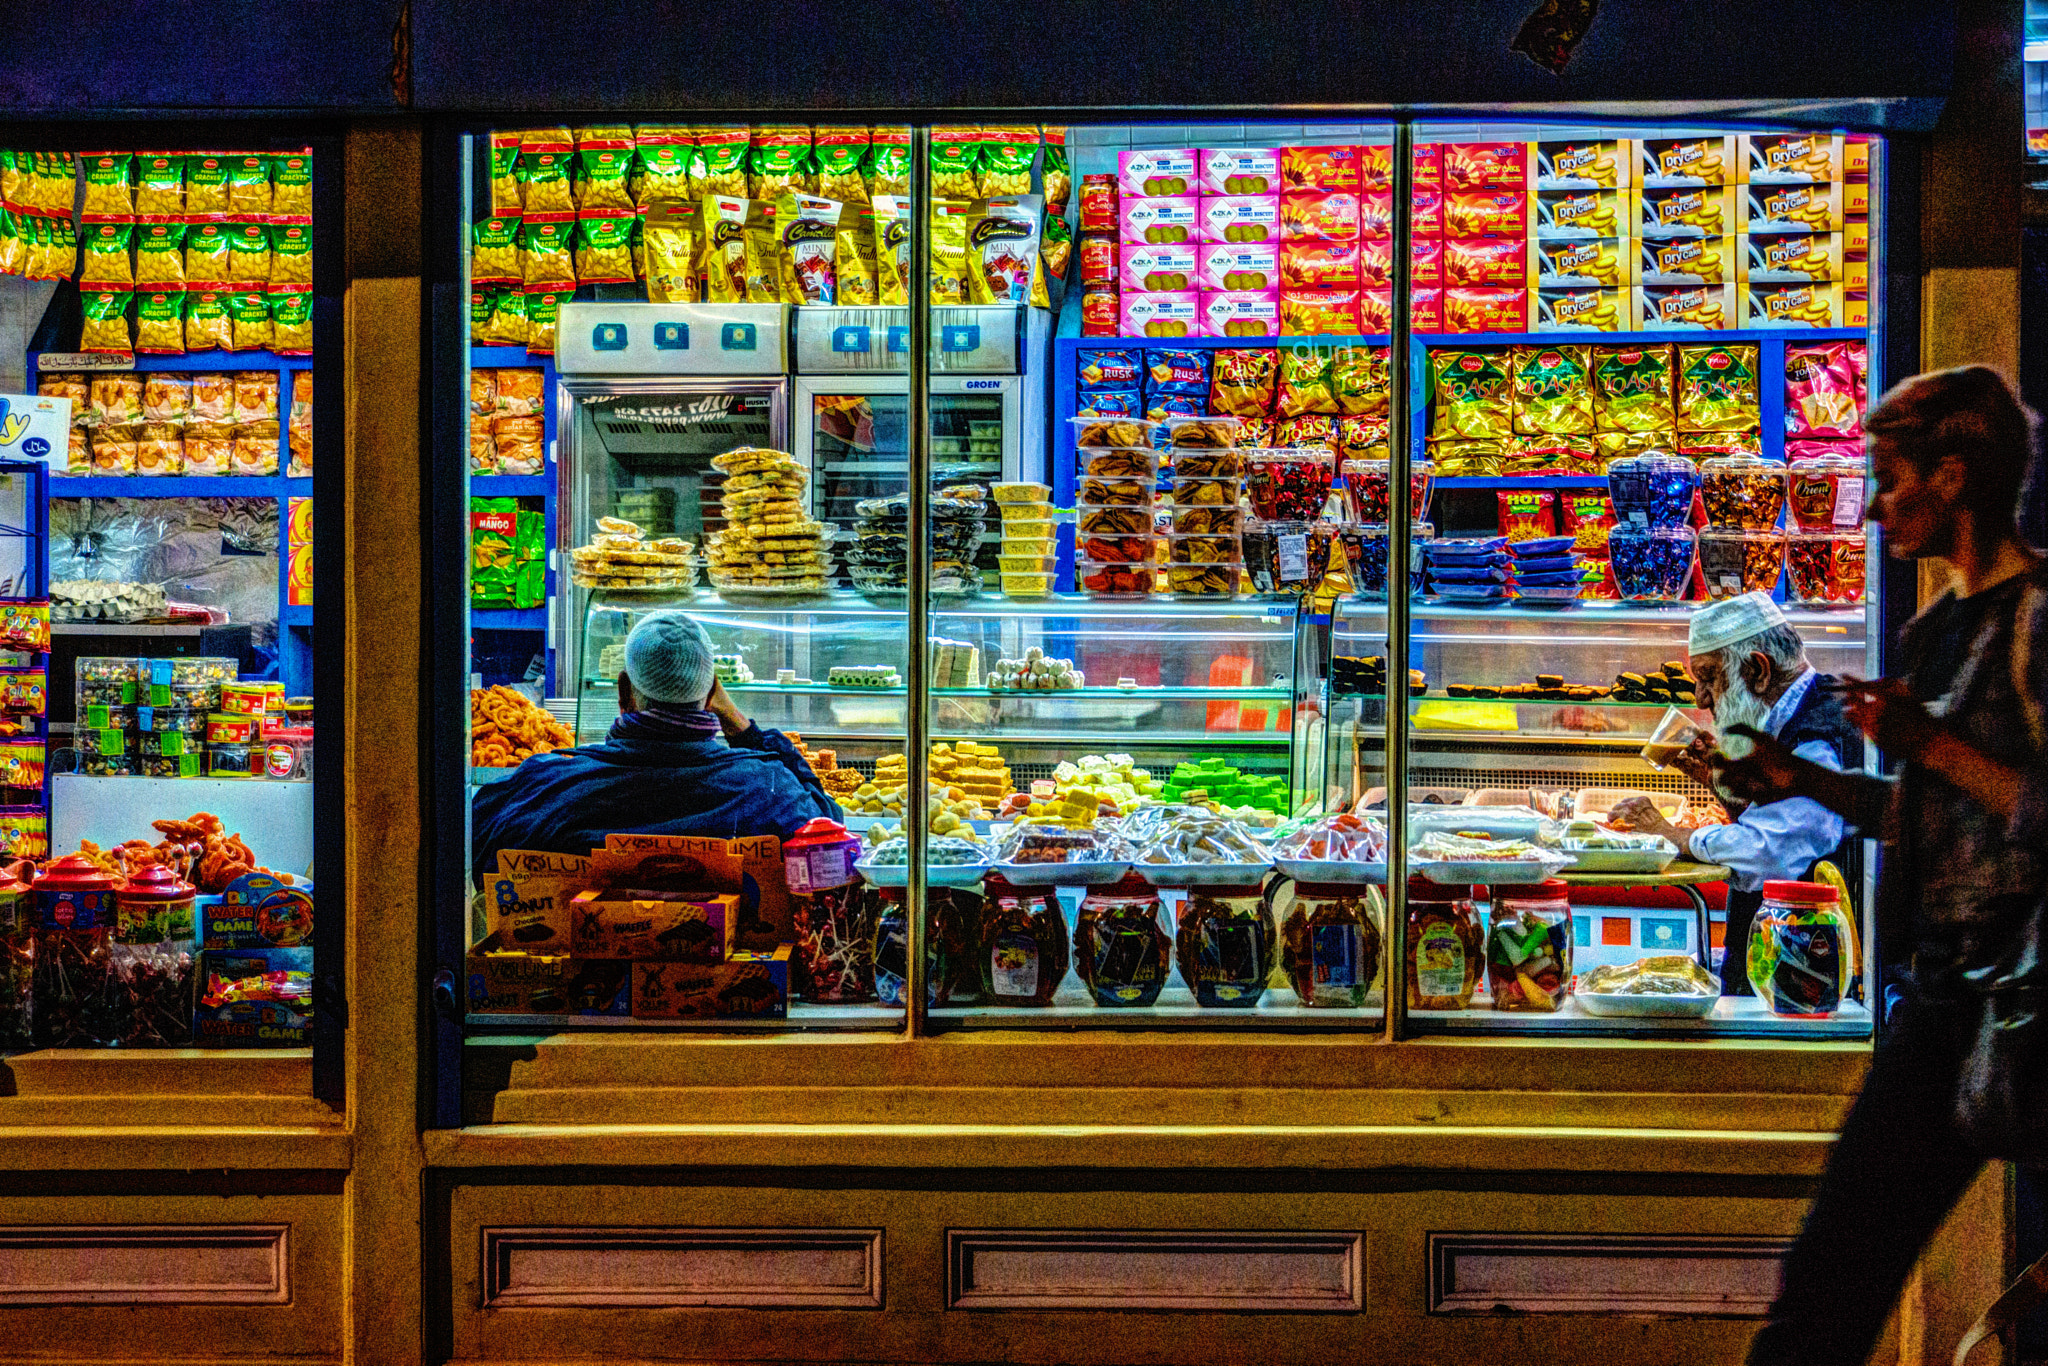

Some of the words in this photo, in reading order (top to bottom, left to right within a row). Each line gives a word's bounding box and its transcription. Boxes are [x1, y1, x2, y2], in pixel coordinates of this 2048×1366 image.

[1492, 148, 1519, 156] AZKA
[1666, 154, 1684, 167] Dry
[1684, 151, 1703, 162] Cake
[1772, 150, 1791, 163] Dry
[1791, 146, 1810, 158] Cake
[1560, 156, 1578, 169] Dry
[1578, 154, 1596, 165] Cake
[590, 168, 620, 176] CRACKER
[1559, 205, 1578, 218] Dry
[1578, 202, 1596, 214] Cake
[1665, 203, 1683, 216] Dry
[1683, 200, 1702, 211] Cake
[1771, 200, 1789, 212] Dry
[1789, 196, 1809, 208] Cake
[803, 244, 827, 252] MINI
[1664, 251, 1683, 264] Dry
[1682, 248, 1702, 260] Cake
[1771, 250, 1789, 262] Dry
[1790, 245, 1809, 257] Cake
[1561, 253, 1579, 266] Dry
[1579, 250, 1598, 262] Cake
[1560, 302, 1578, 315] Dry
[1578, 298, 1597, 310] Cake
[1666, 300, 1683, 313] Dry
[1683, 296, 1702, 308] Cake
[1772, 299, 1790, 311] Dry
[1790, 294, 1810, 306] Cake
[1217, 355, 1268, 380] Toast
[1786, 355, 1824, 372] SWEET
[1104, 369, 1132, 378] RUSK
[1174, 369, 1201, 380] RUSK
[1795, 367, 1817, 377] TOAS
[966, 381, 1000, 389] GROEN
[1444, 377, 1500, 398] TOAST
[1522, 374, 1579, 397] TOAST
[1603, 371, 1660, 394] TOAST
[1689, 376, 1747, 397] TOAST
[1099, 401, 1118, 409] Ghee
[1235, 418, 1269, 439] ast
[1282, 416, 1331, 444] Toast
[1346, 424, 1389, 444] Toas
[1794, 480, 1832, 496] Orient
[1507, 494, 1541, 505] HOT
[1572, 497, 1608, 507] HOT
[479, 520, 510, 529] MANGO
[1836, 545, 1865, 564] Orien
[495, 880, 518, 905] 8
[208, 906, 254, 918] WATER
[500, 896, 554, 916] DONUT
[213, 920, 253, 932] GAME
[514, 915, 546, 926] Chocolate
[614, 920, 652, 932] WAFFLE
[710, 946, 720, 954] 24
[469, 974, 488, 999] 8
[675, 978, 715, 990] WAFFLE
[618, 1002, 628, 1010] 24
[774, 1003, 783, 1012] 24
[202, 1020, 255, 1036] WATER
[259, 1026, 304, 1040] GAME
